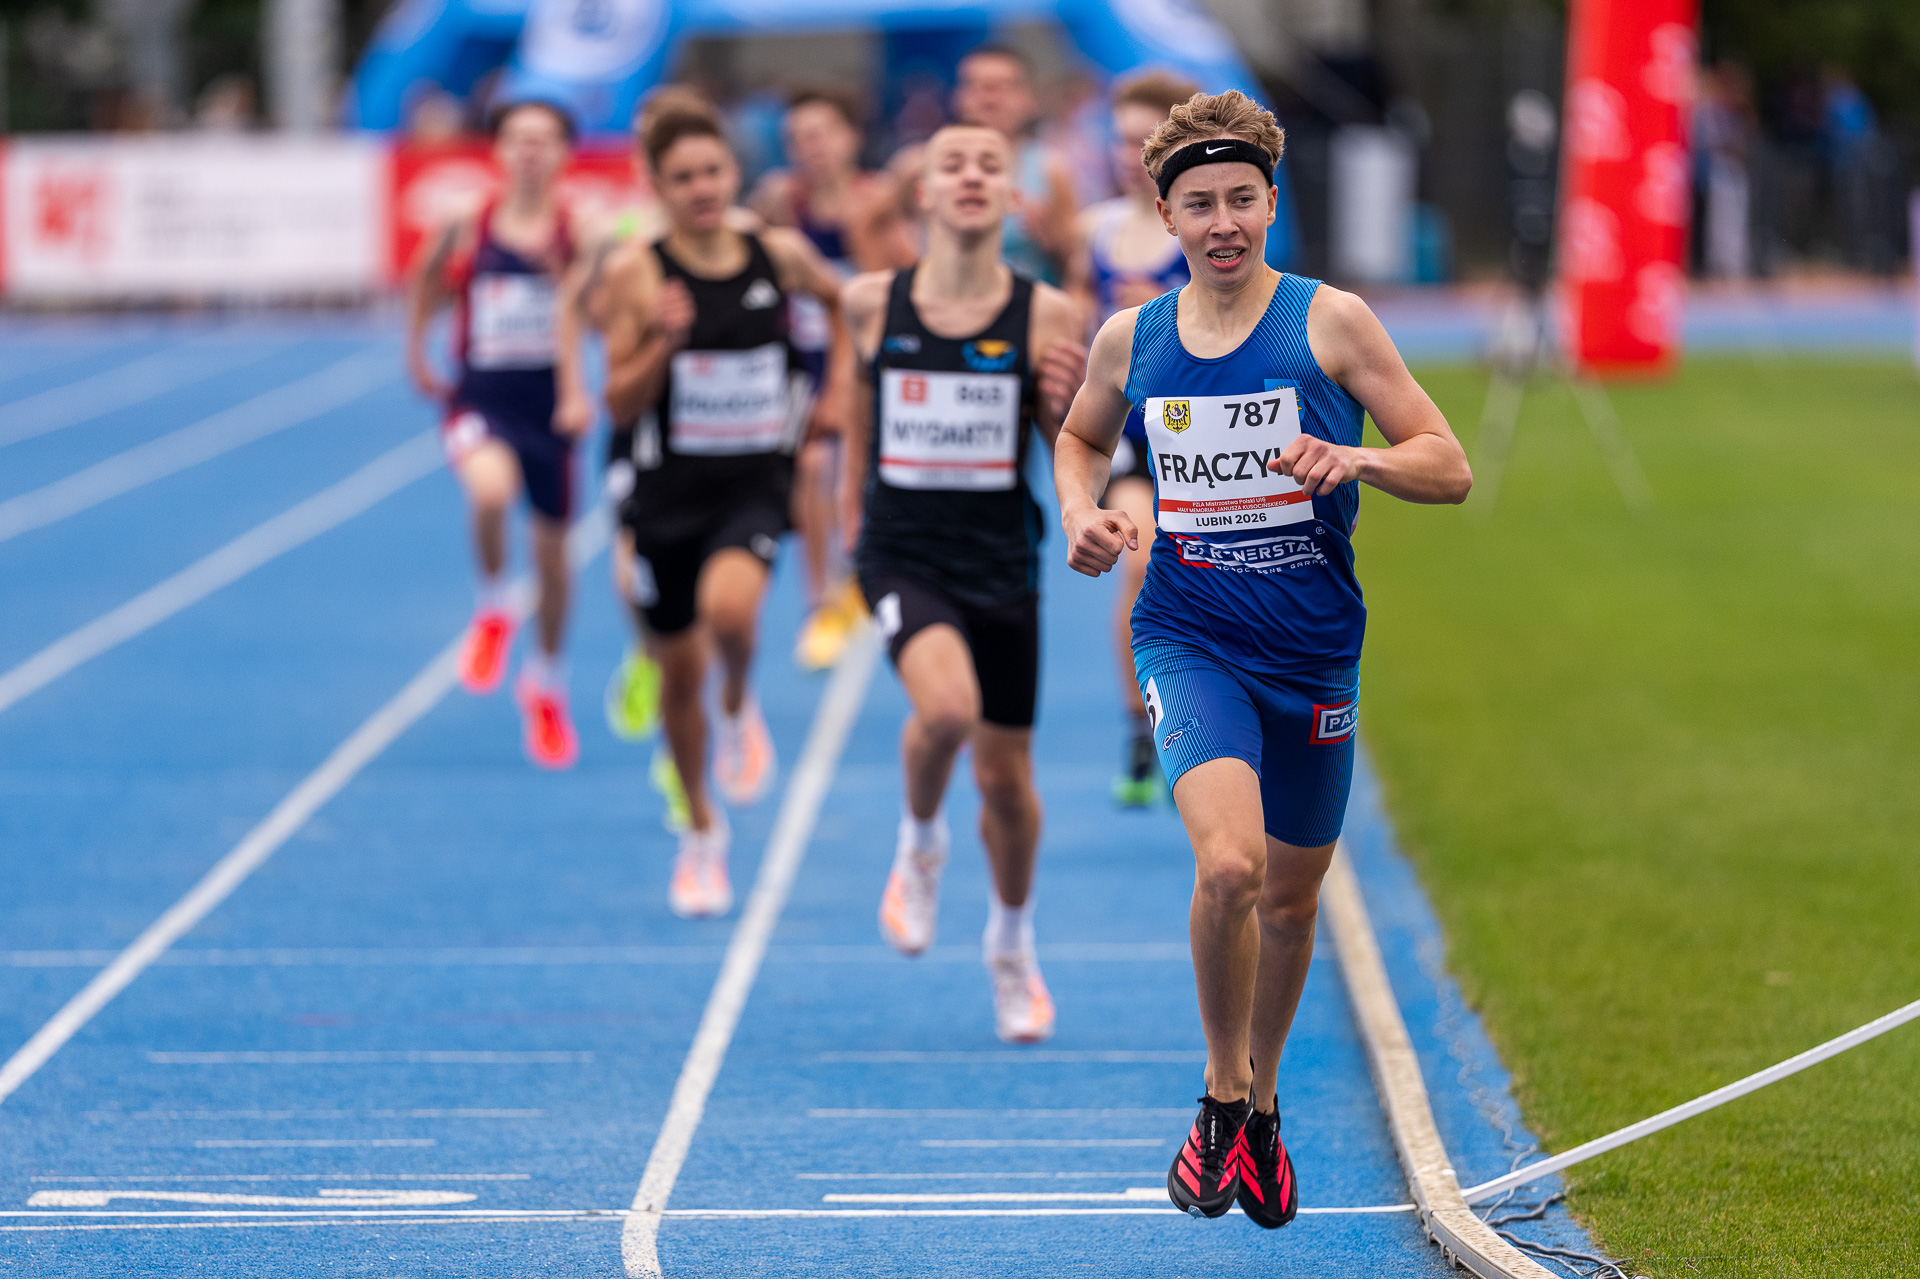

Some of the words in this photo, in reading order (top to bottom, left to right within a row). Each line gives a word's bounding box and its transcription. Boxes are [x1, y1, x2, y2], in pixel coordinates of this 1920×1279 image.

[1223, 398, 1281, 429] 787
[1189, 506, 1216, 514] MEMORIAŁ
[1242, 499, 1288, 510] KUSOCIŃSKIEGO
[1205, 499, 1238, 507] Mistrzostwa
[1239, 497, 1256, 505] Polski
[1195, 515, 1233, 527] LUBIN
[1235, 512, 1267, 524] 2026
